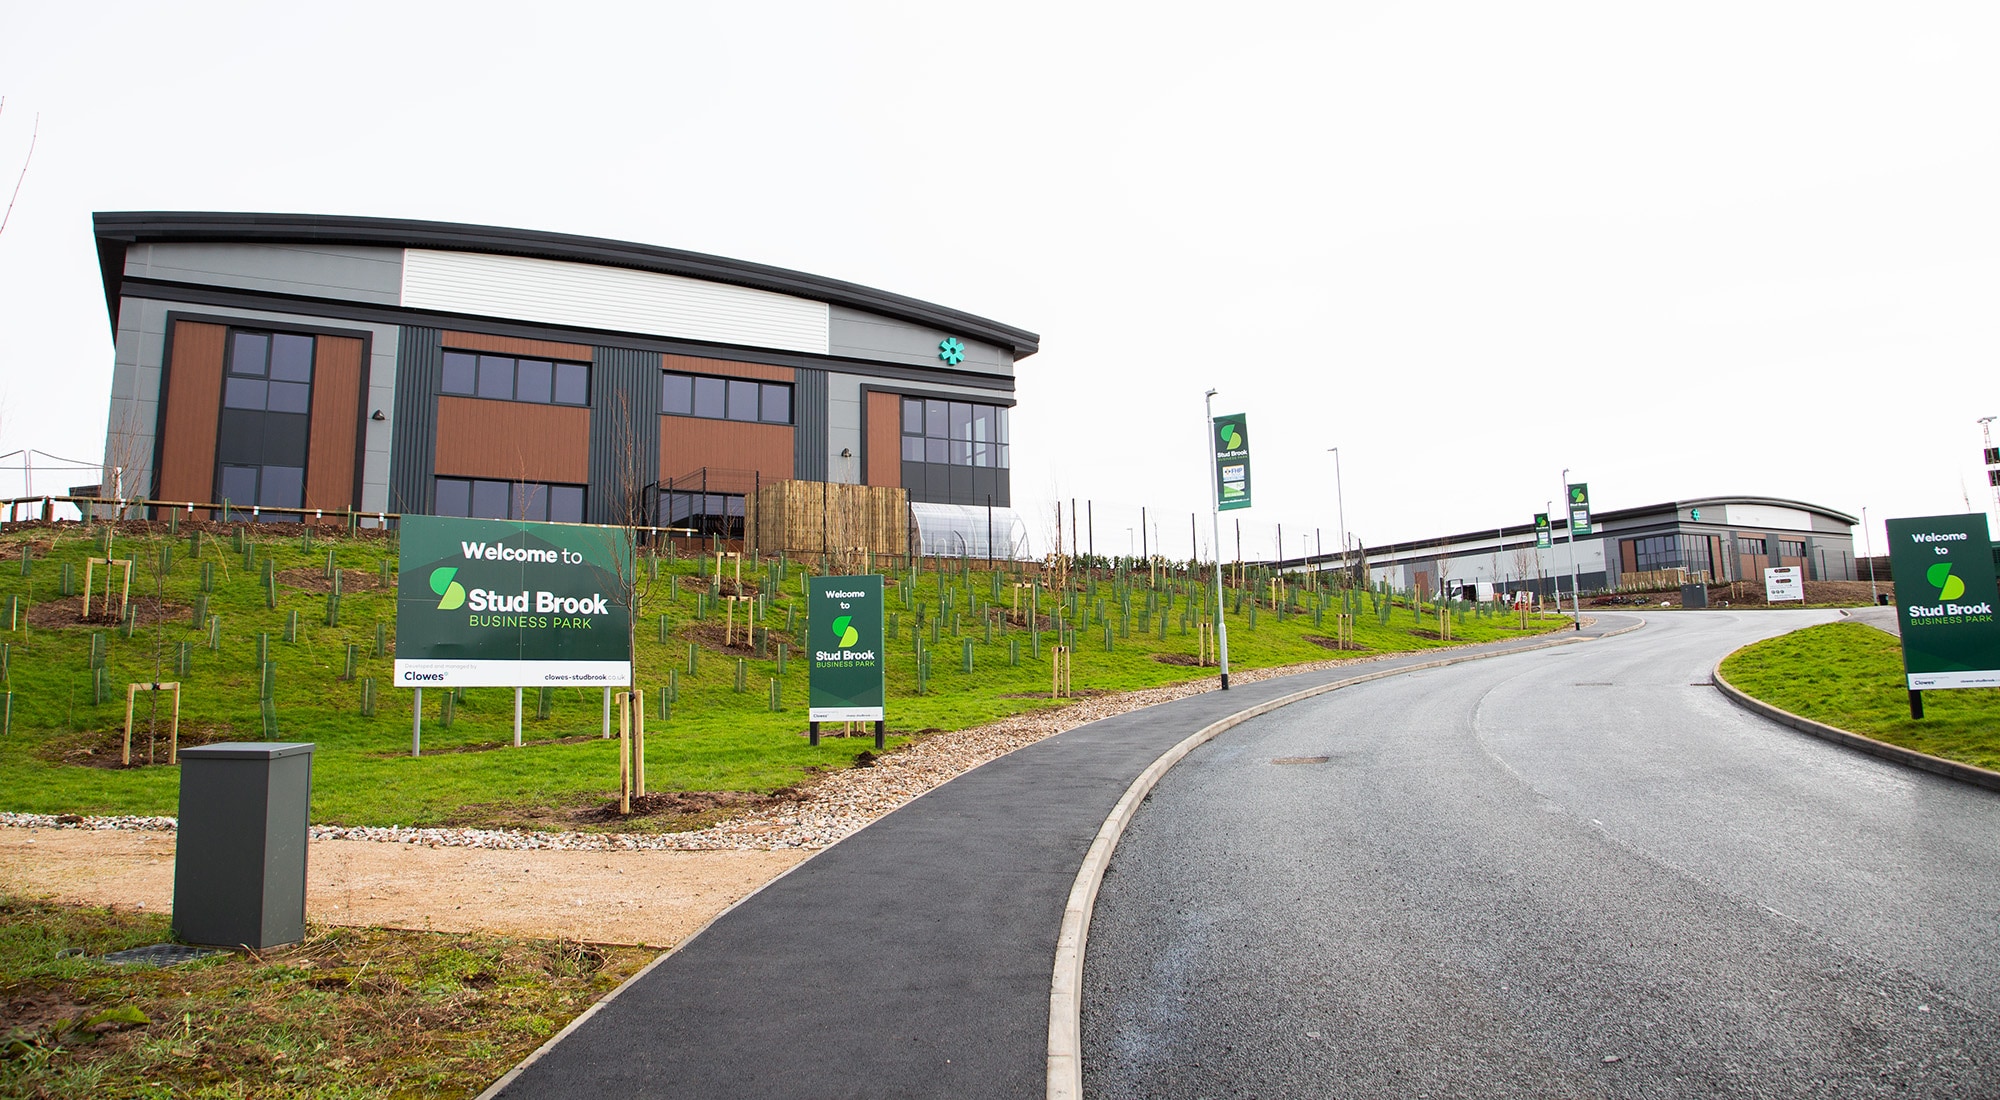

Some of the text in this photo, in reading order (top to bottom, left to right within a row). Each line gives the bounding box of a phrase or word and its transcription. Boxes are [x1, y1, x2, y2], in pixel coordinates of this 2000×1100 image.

[1911, 532, 1968, 543] Welcome
[461, 541, 583, 565] Welcome to
[1934, 546, 1949, 555] to
[825, 590, 865, 599] Welcome
[468, 588, 609, 615] Stud Brook
[839, 601, 851, 610] to
[1909, 602, 1992, 617] Stud Brook
[469, 615, 592, 629] BUSINESS PARK
[1910, 614, 1994, 626] BUSINESS PARK
[816, 650, 875, 661] Stud Brook
